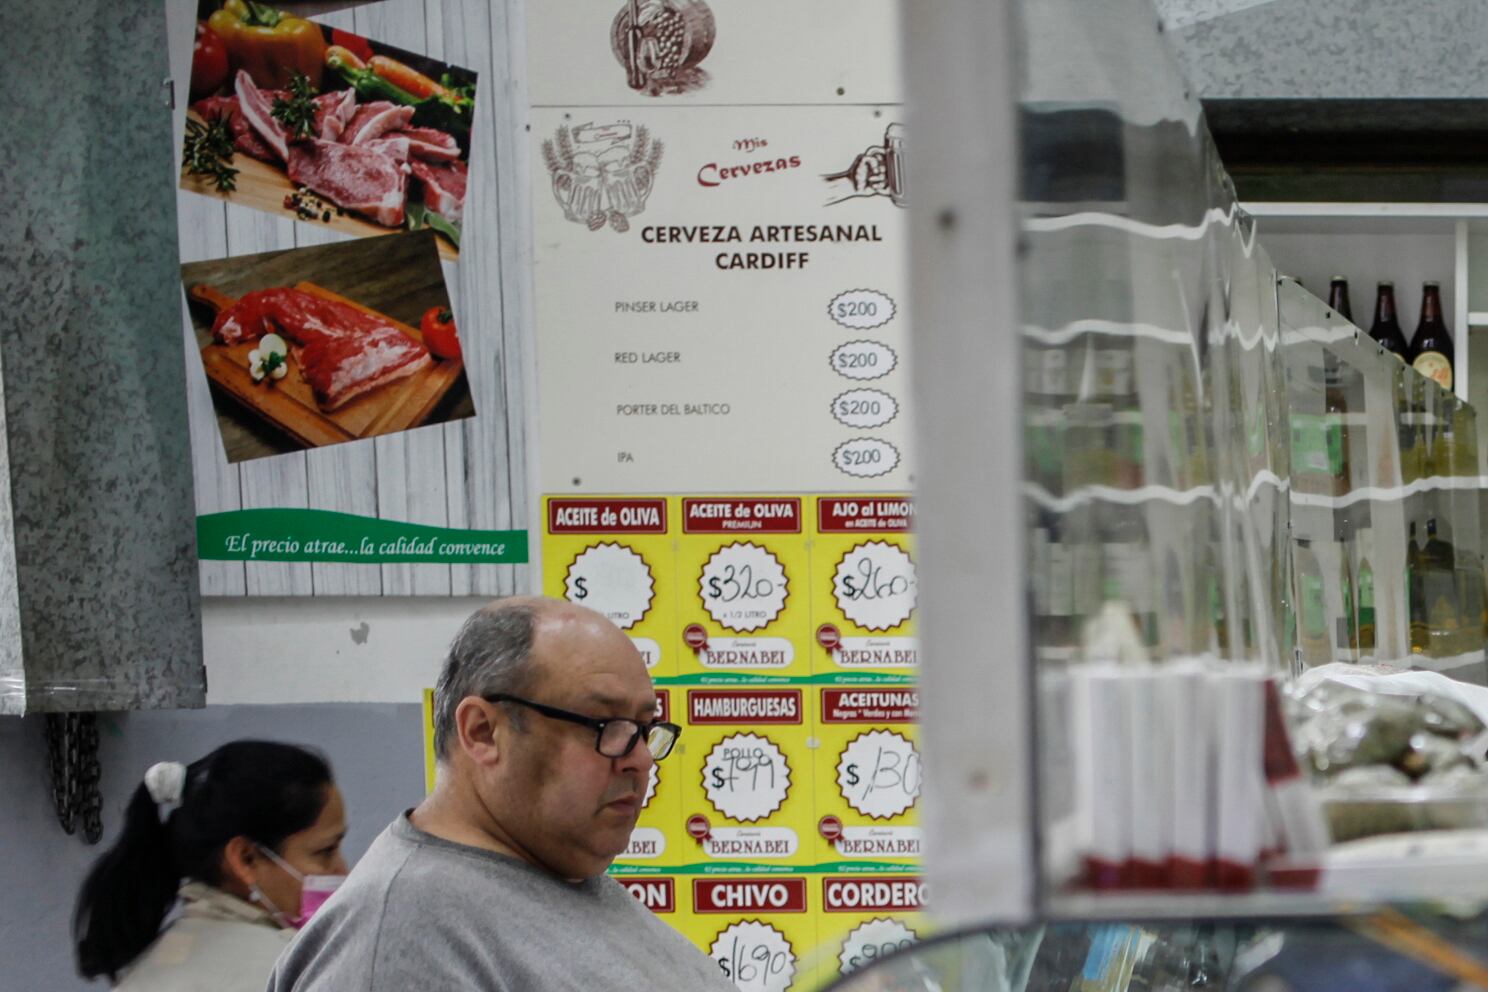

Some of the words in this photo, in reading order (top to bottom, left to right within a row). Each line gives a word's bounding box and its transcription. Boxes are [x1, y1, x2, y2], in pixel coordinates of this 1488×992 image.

[732, 137, 768, 153] Mis
[697, 155, 801, 187] Cervezas
[641, 225, 742, 243] CERVEZA
[750, 225, 882, 242] ARTESANAL
[715, 252, 809, 270] CARDIFF
[615, 302, 656, 313] PINSER
[660, 301, 699, 312] LAGER
[837, 302, 877, 318] $200
[614, 352, 637, 363] RED
[641, 352, 681, 363] LAGER
[838, 352, 878, 368] $200
[616, 404, 657, 416] PORTER
[661, 404, 680, 415] DEL
[684, 404, 730, 415] BALTICO
[839, 400, 880, 416] $200
[617, 452, 634, 463] IPA
[842, 449, 881, 466] $200
[556, 507, 598, 526] ACEITE
[601, 507, 617, 525] de
[620, 507, 660, 526] OLIVA
[690, 503, 732, 519] ACEITE
[735, 504, 751, 518] de
[754, 503, 793, 518] OLIVA
[832, 503, 858, 516] AJO
[861, 502, 874, 516] al
[225, 533, 248, 553] El
[251, 537, 300, 558] precio
[378, 535, 437, 556] calidad
[439, 543, 505, 557] convence
[744, 610, 767, 619] LITRO
[706, 651, 785, 665] BERNABEI
[693, 697, 796, 718] HAMBURGUESAS
[711, 840, 789, 854] BERNABEI
[711, 884, 788, 908] CHIVO
